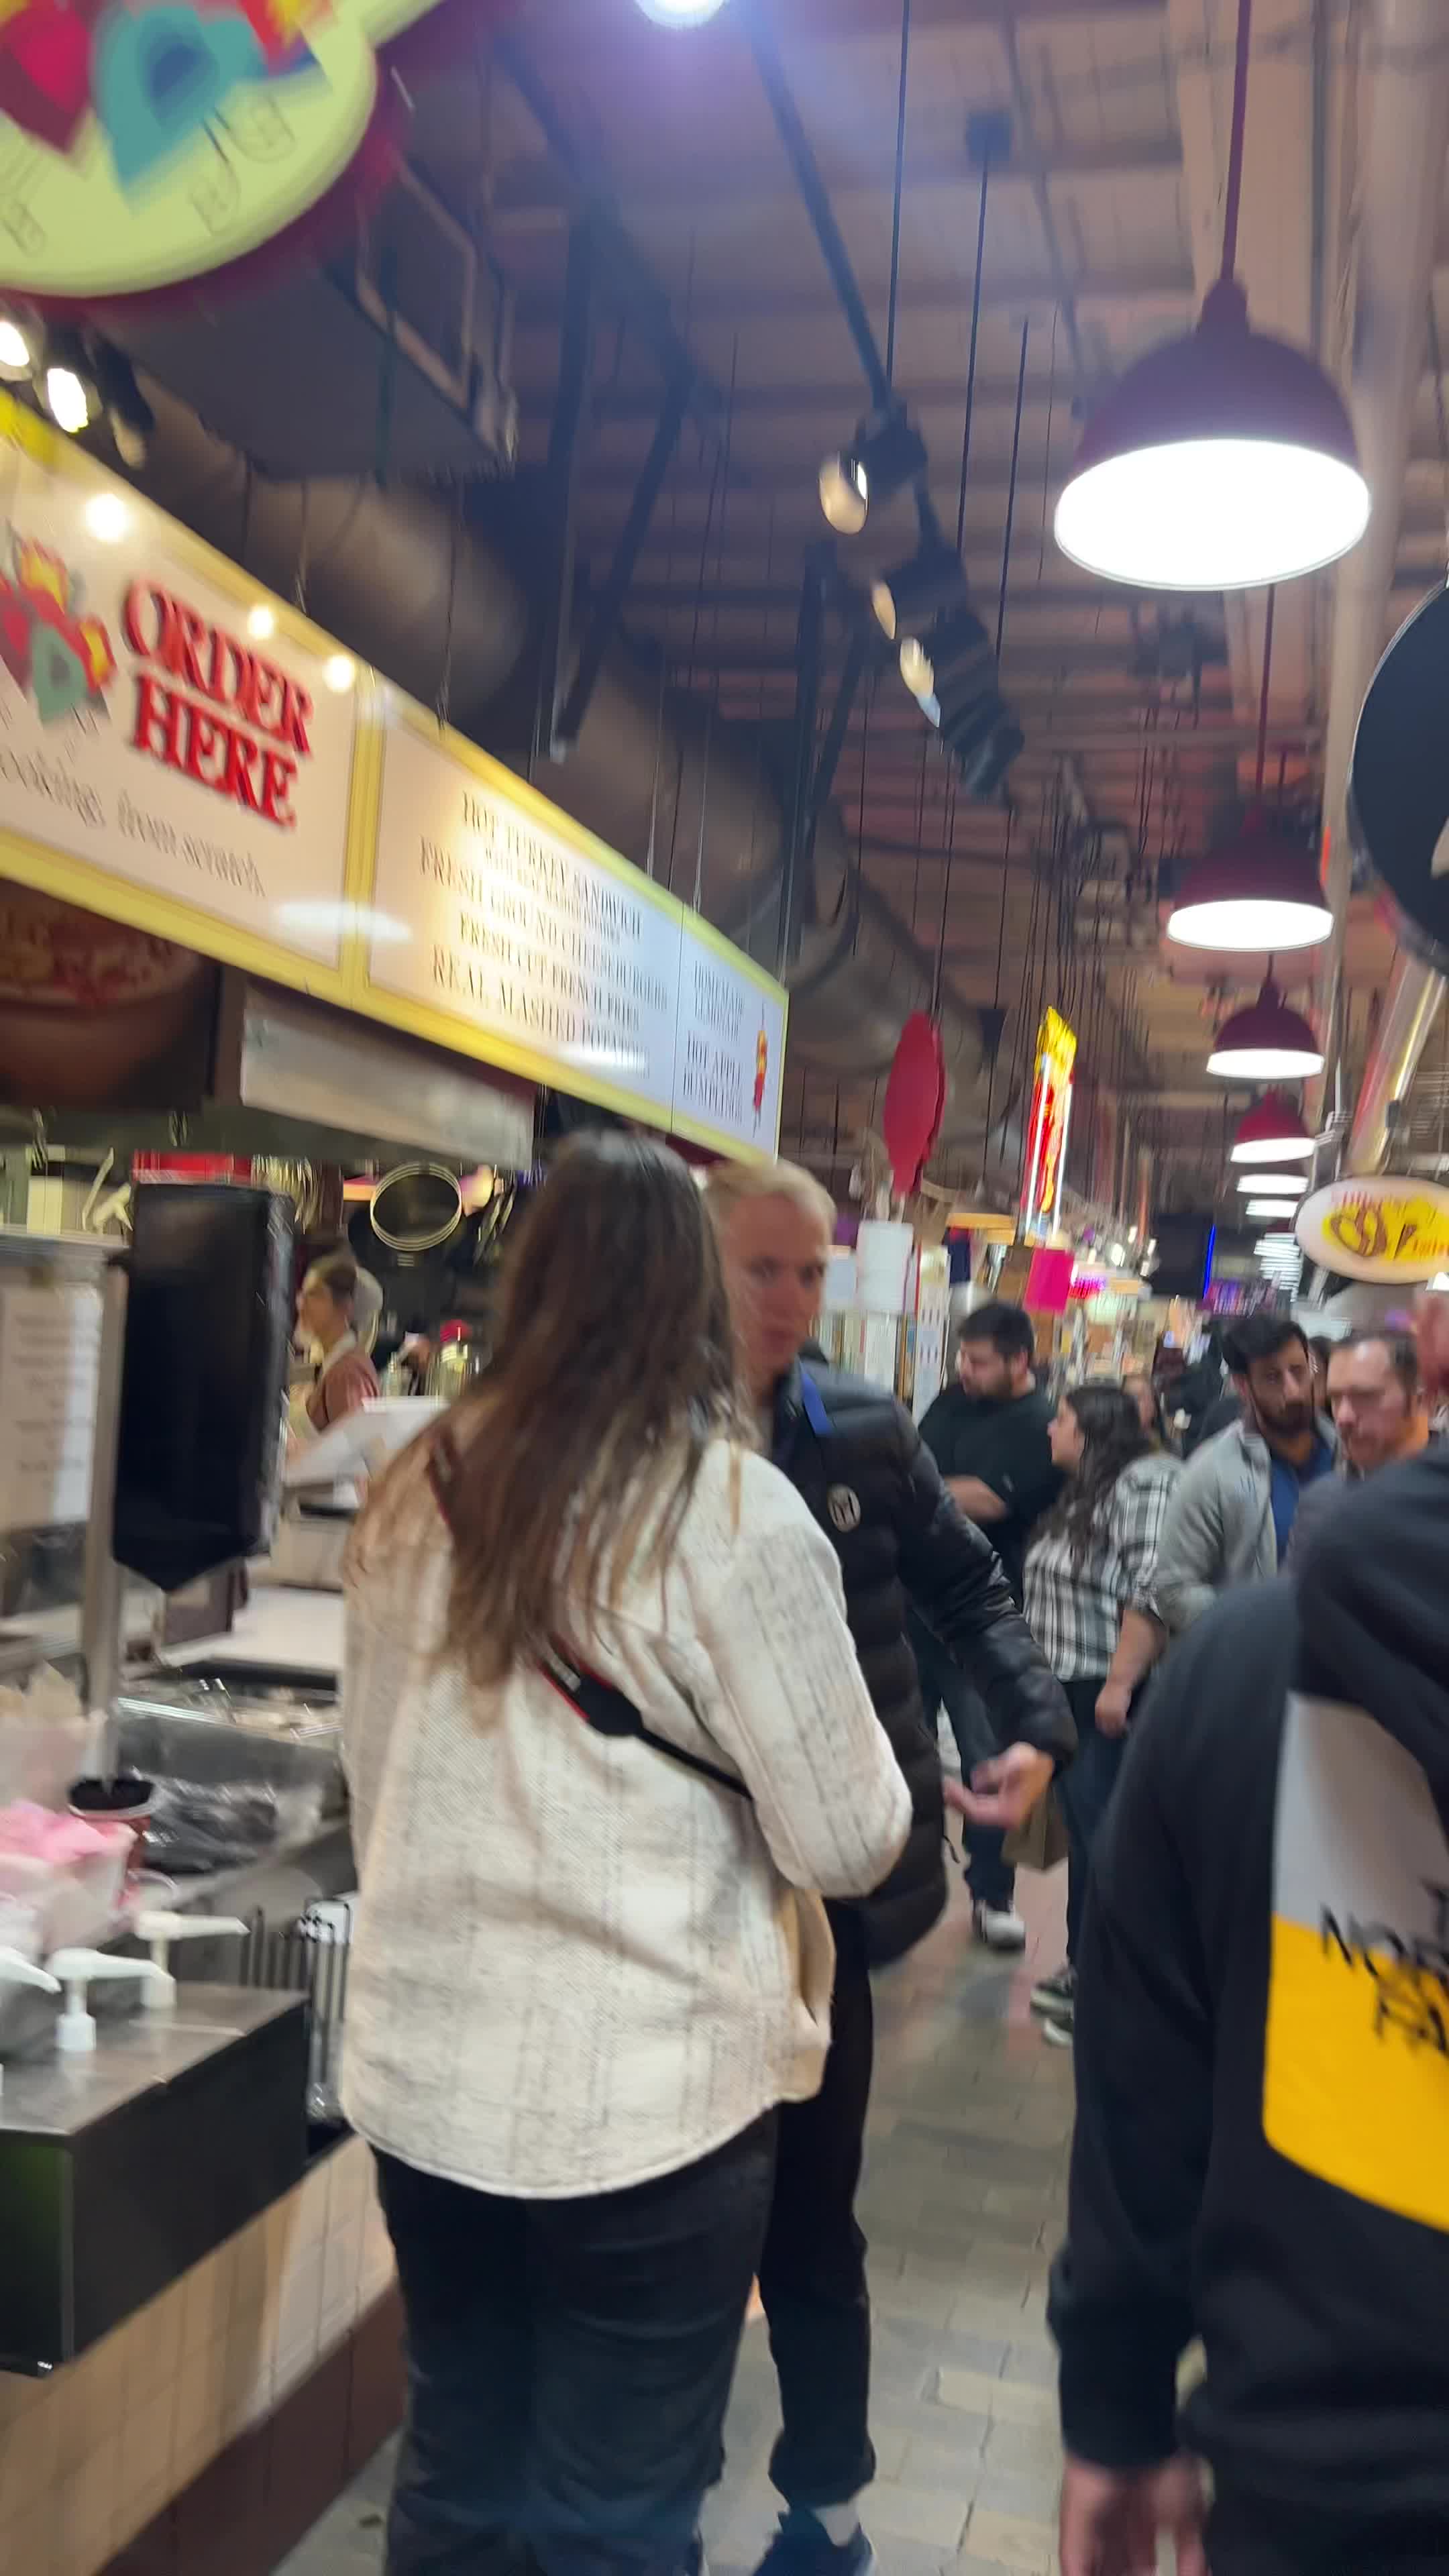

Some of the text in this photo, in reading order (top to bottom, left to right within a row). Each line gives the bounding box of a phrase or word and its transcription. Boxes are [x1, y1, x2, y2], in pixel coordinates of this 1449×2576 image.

[124, 576, 313, 757] ORDER
[131, 672, 297, 830] HERE
[420, 834, 483, 903] FRESH
[463, 790, 499, 843] HOT
[506, 825, 568, 887] TURKEY
[573, 871, 643, 941] SANDWICH
[431, 943, 490, 1009] REAL
[499, 978, 576, 1042] MASHED
[460, 910, 511, 963] FRESH
[551, 961, 602, 1014] FRENCH
[607, 993, 639, 1032] FRIES
[687, 1030, 709, 1069] HOT
